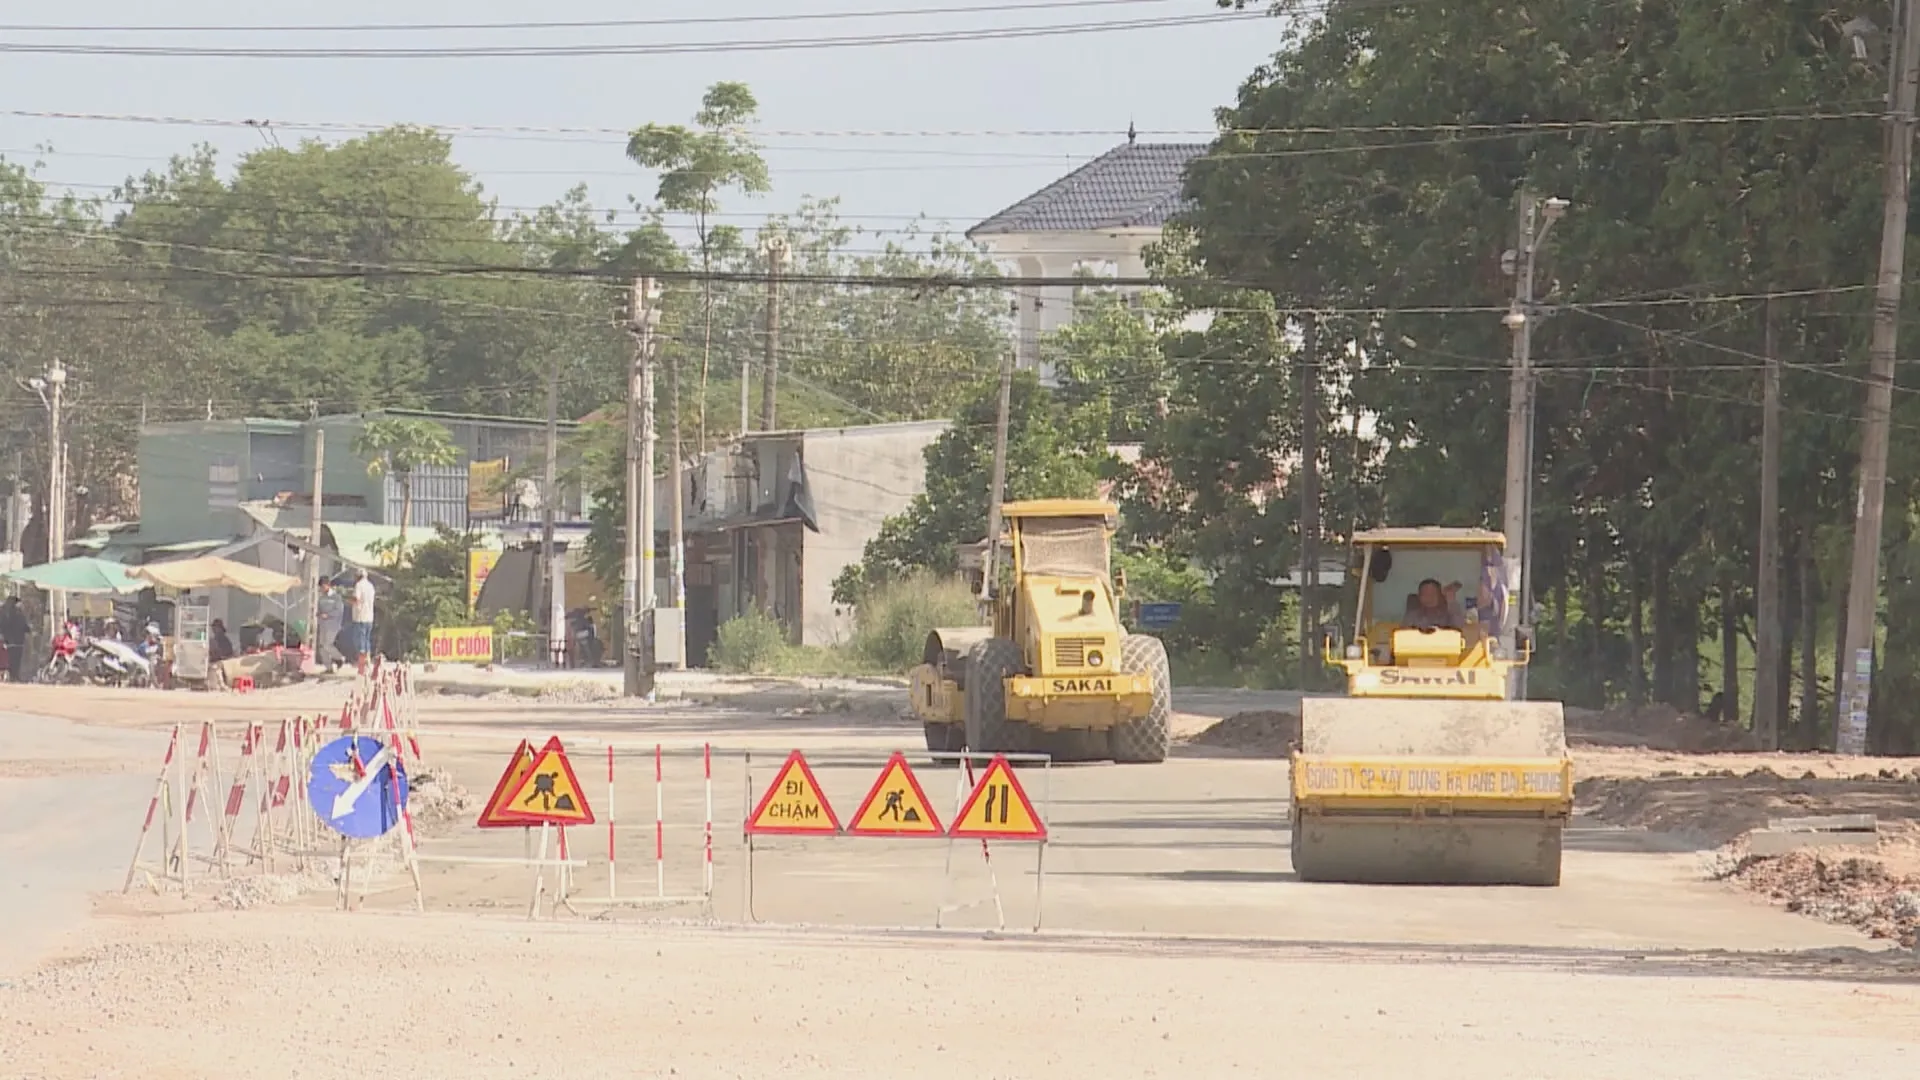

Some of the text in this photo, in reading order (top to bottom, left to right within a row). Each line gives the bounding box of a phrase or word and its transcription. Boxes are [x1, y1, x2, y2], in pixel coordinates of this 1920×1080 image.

[1053, 679, 1112, 692] SAKAI
[1343, 767, 1356, 790] TY
[786, 780, 803, 796] ĐI
[769, 800, 819, 821] CHẬM
